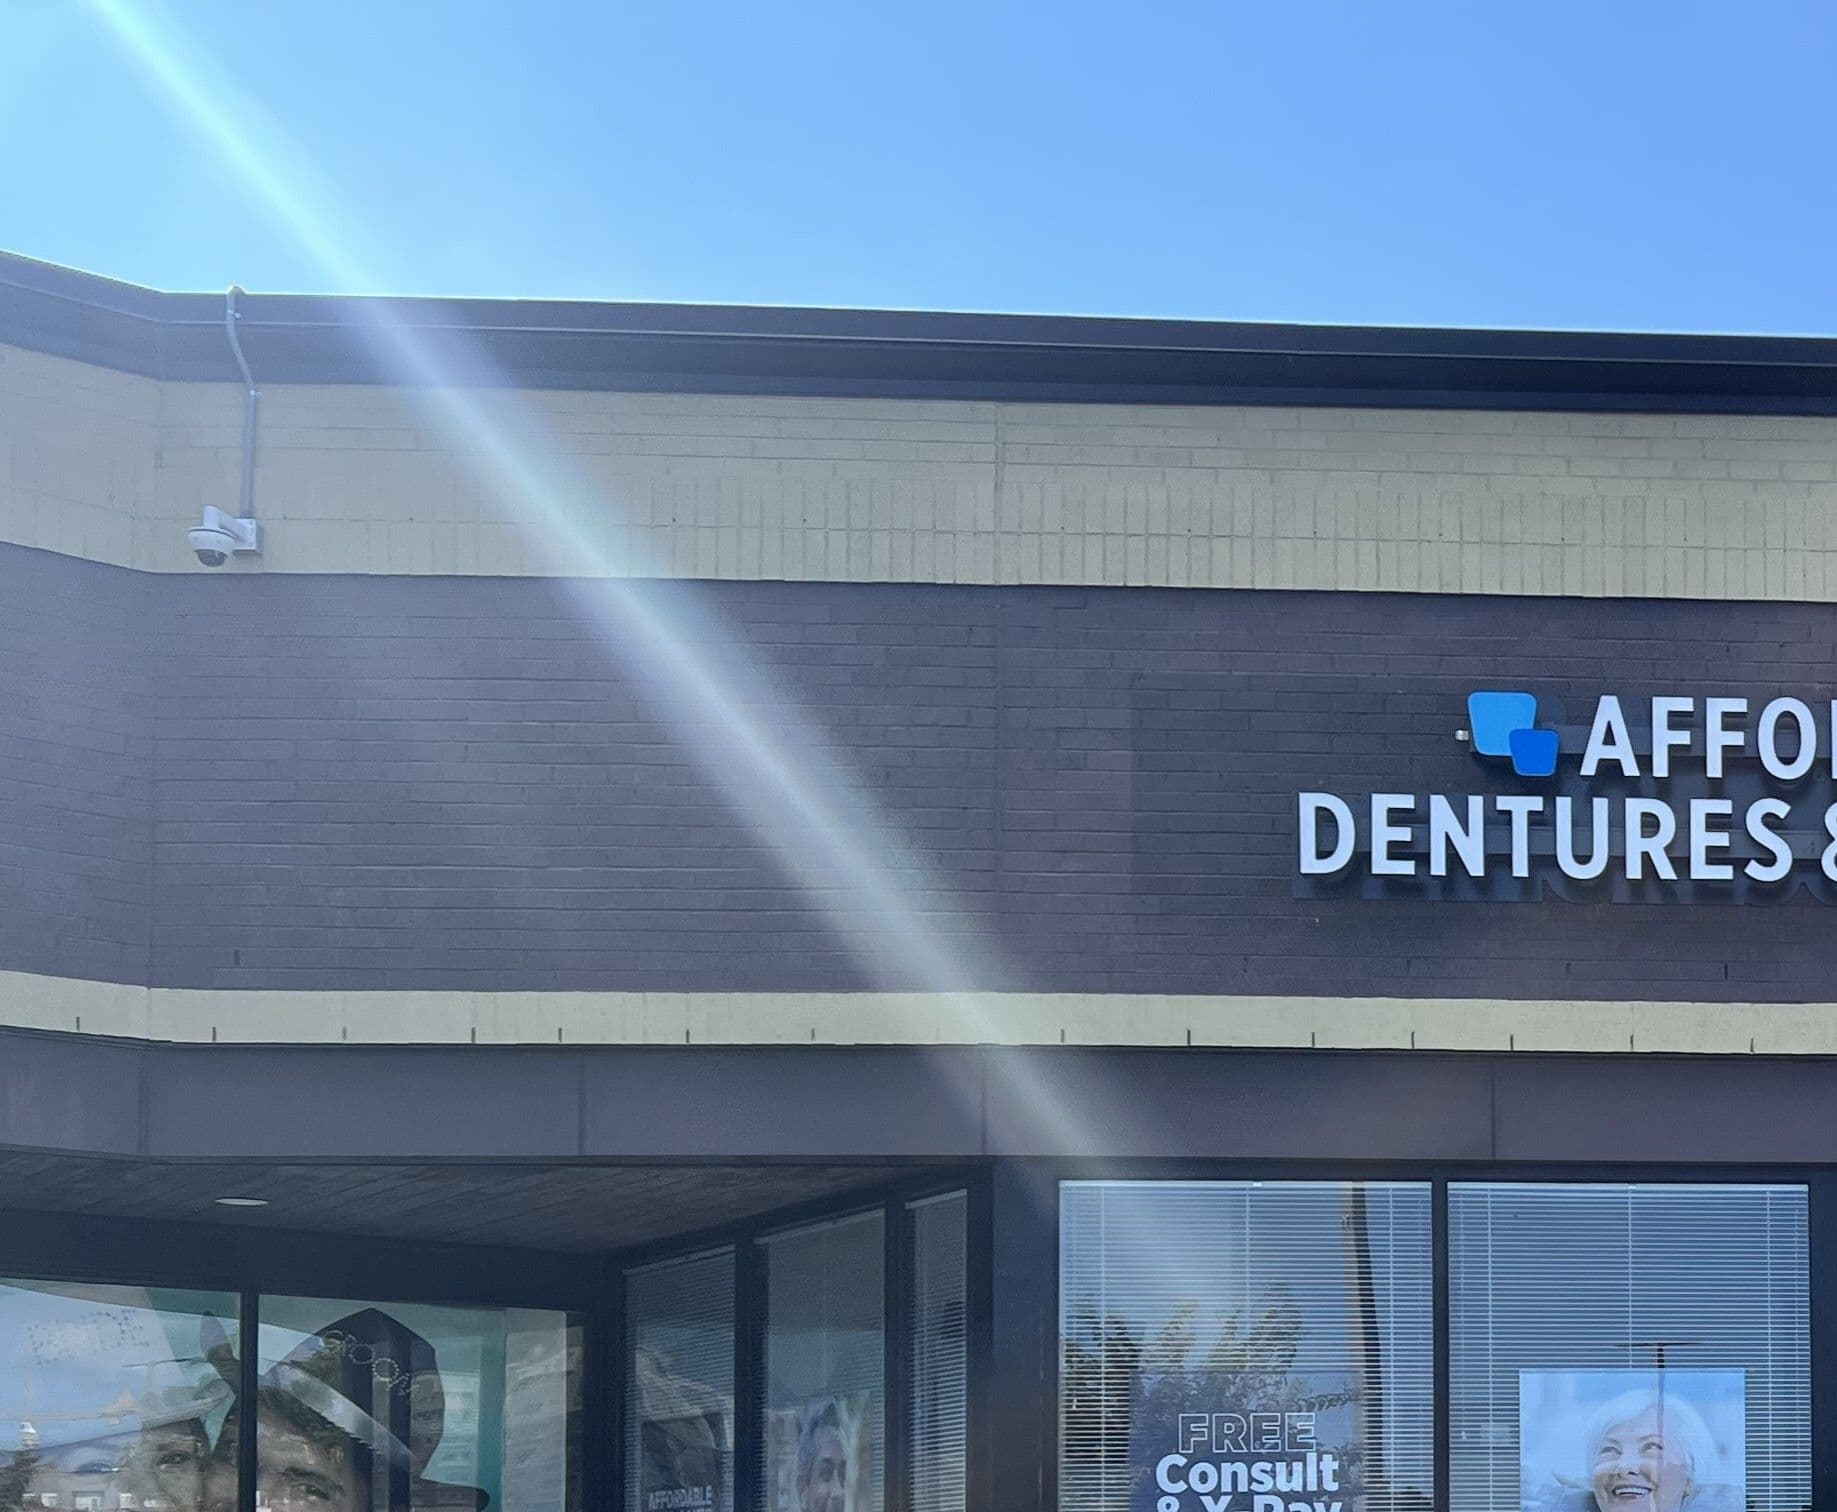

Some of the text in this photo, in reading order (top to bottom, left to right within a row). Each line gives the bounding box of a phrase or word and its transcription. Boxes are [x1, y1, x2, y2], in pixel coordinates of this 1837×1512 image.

[1298, 791, 1795, 882] DENTURES
[1178, 1412, 1317, 1453] FREE
[1155, 1452, 1340, 1494] Consult
